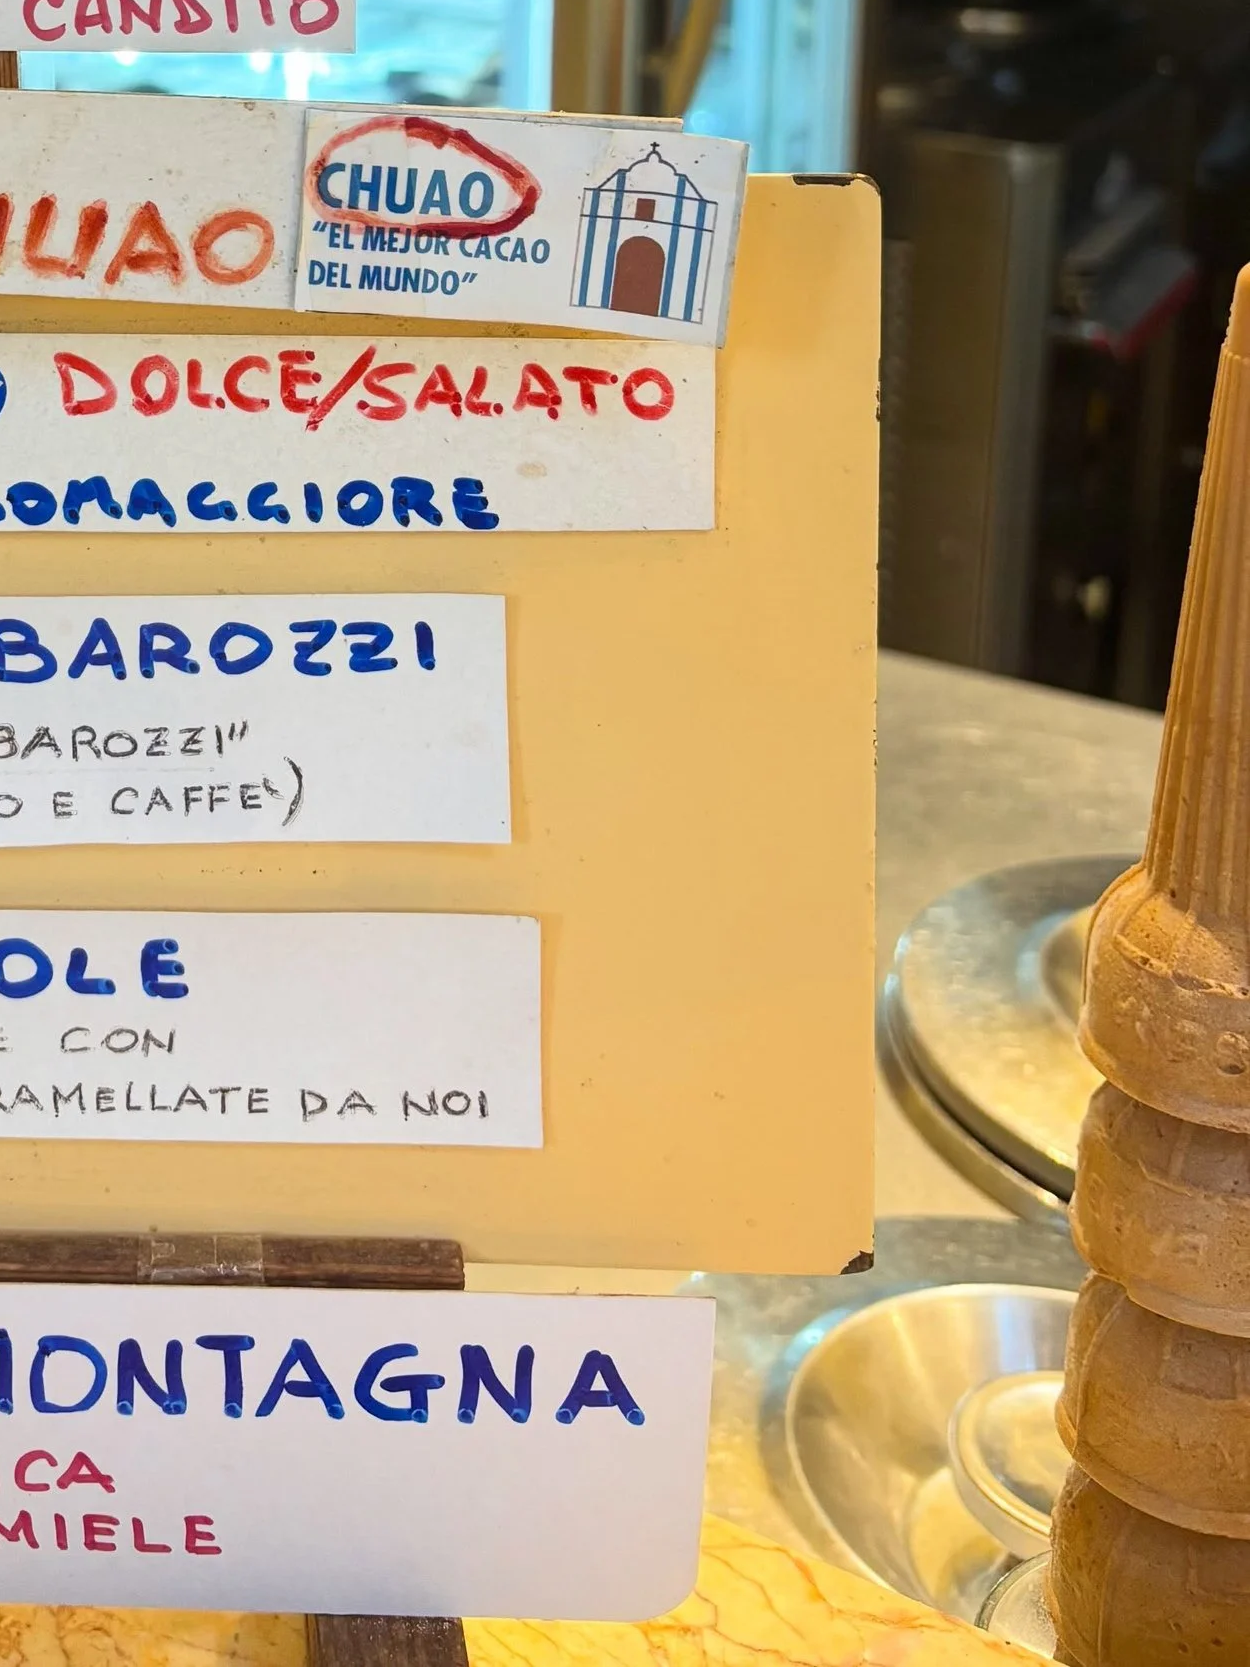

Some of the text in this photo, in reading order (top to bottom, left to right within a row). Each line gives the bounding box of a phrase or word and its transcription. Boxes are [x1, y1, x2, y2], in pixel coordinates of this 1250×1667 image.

[317, 162, 495, 219] CHUAO
[361, 225, 451, 256] MEJOR
[457, 232, 552, 265] CACAO
[308, 259, 479, 296] DEL MUNDO”
[52, 344, 677, 432] DOLCE/SALATO
[53, 790, 79, 820] E
[59, 1026, 177, 1055] CON
[300, 1087, 378, 1124] DA
[402, 1088, 491, 1122] NOI
